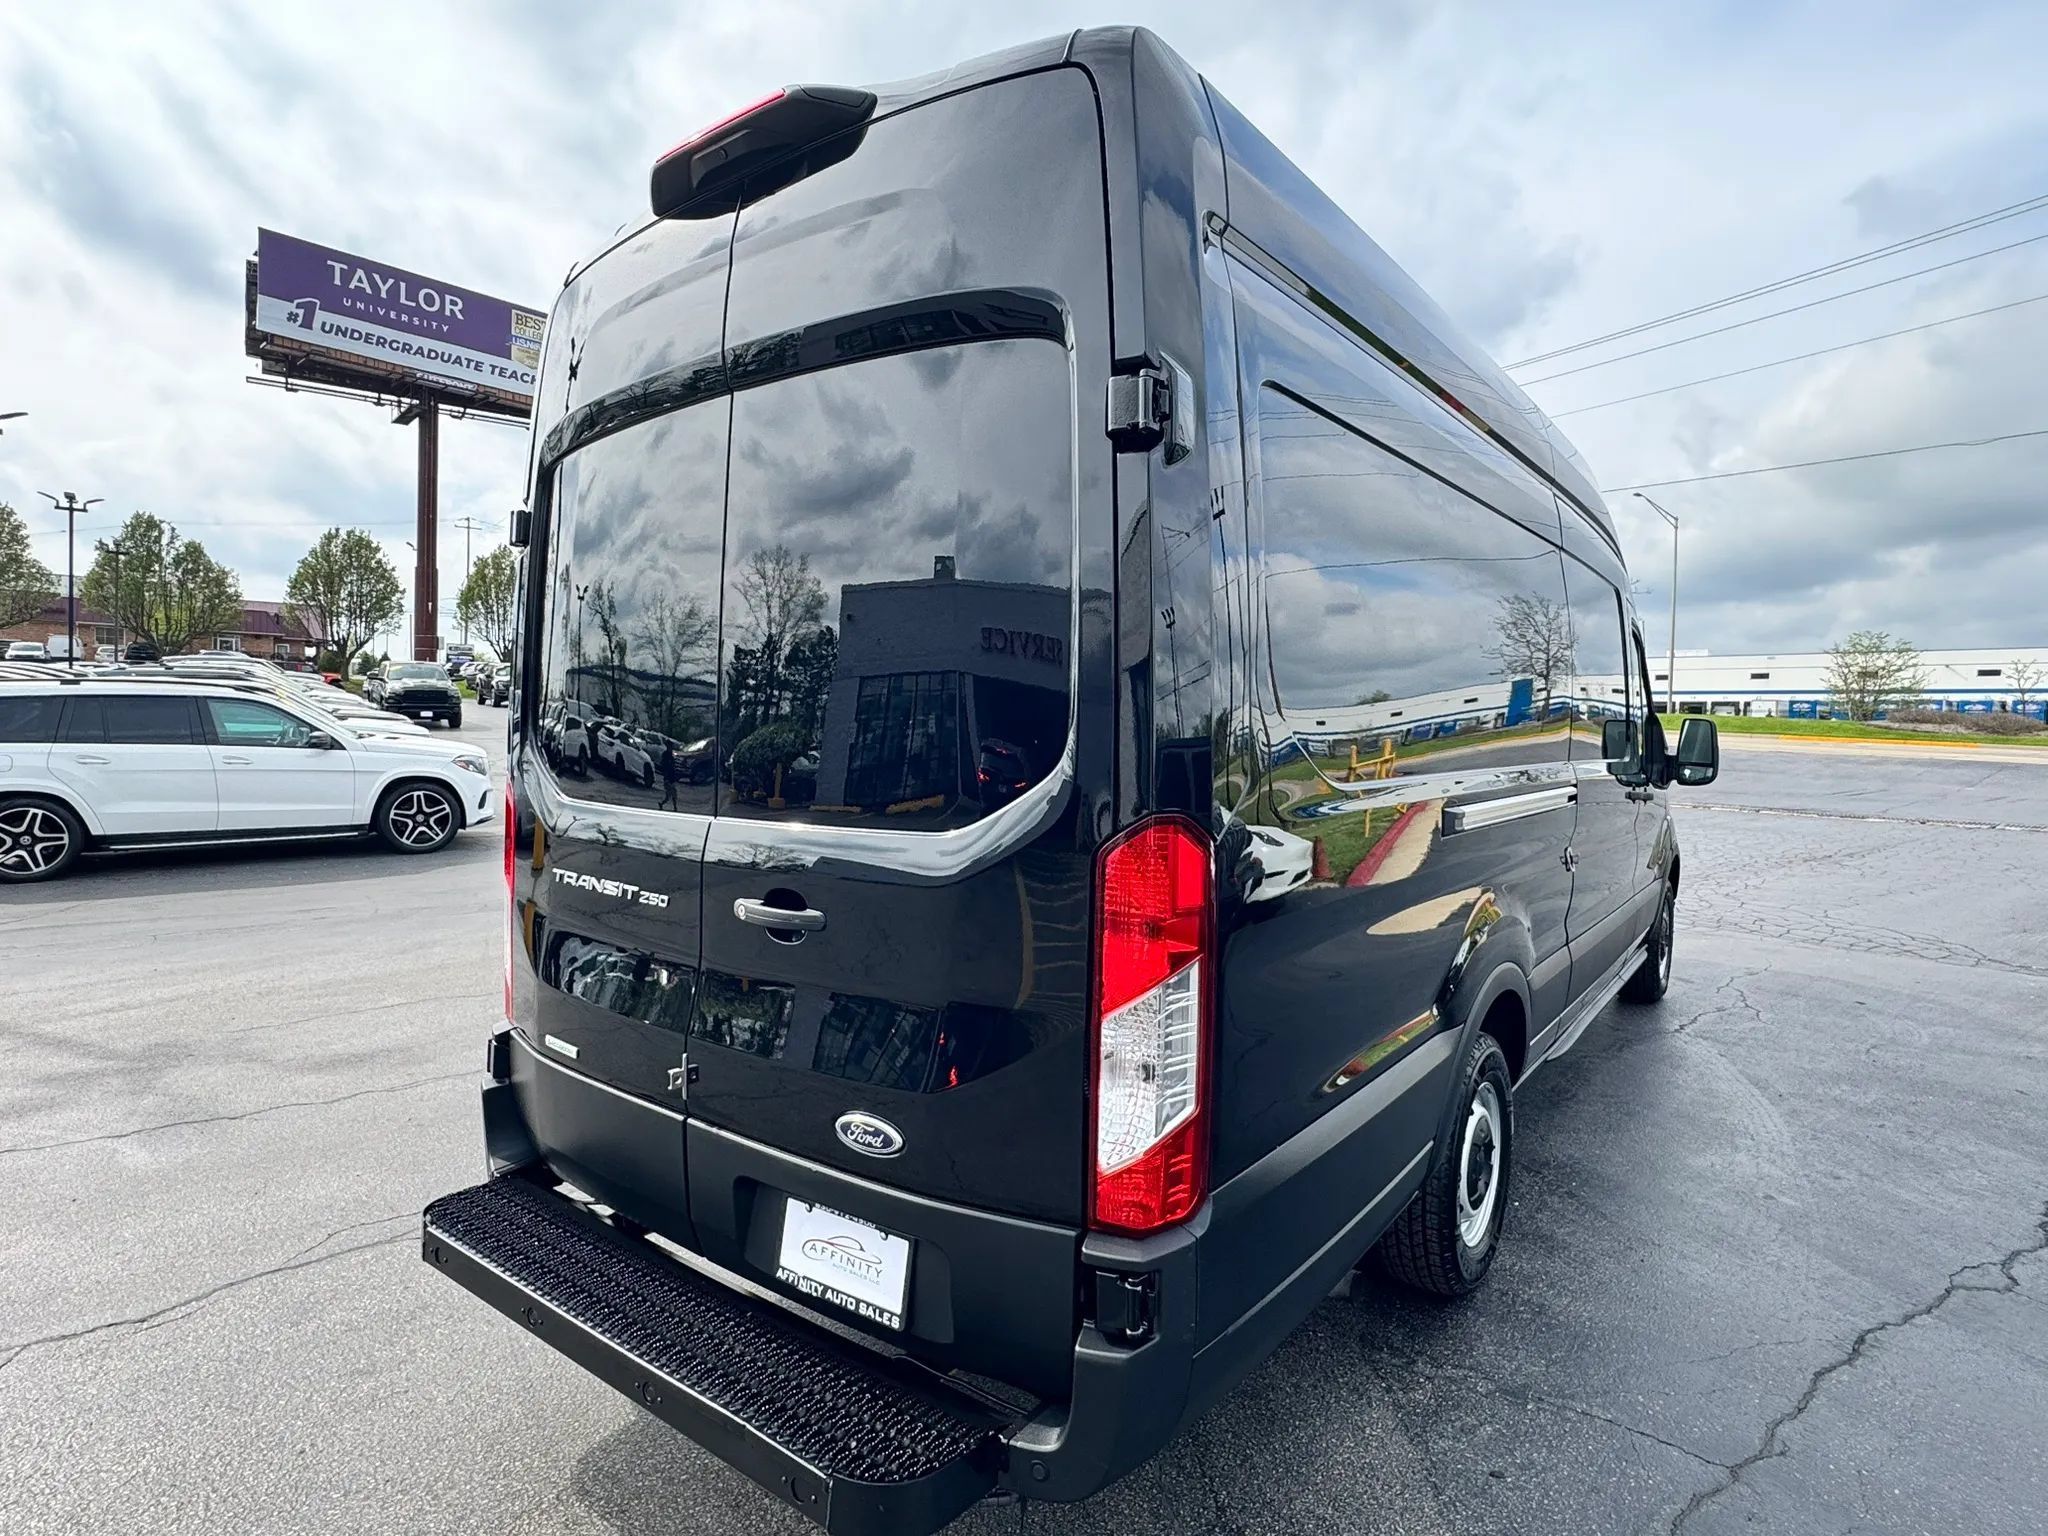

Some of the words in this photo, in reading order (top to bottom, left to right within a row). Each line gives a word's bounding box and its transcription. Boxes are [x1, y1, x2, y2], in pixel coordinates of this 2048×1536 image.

[327, 259, 465, 320] TAYLOR
[286, 297, 320, 331] #1
[320, 321, 484, 373] UNDERGRADUATE
[343, 297, 449, 333] UNIVERSITY
[552, 868, 639, 899] TRANSIT
[638, 890, 669, 908] 250
[847, 1122, 884, 1148] Ford
[809, 1243, 883, 1278] AFFINITY
[776, 1267, 824, 1298] AFFINITY
[825, 1288, 856, 1310] AUTO
[858, 1302, 900, 1329] SALES
